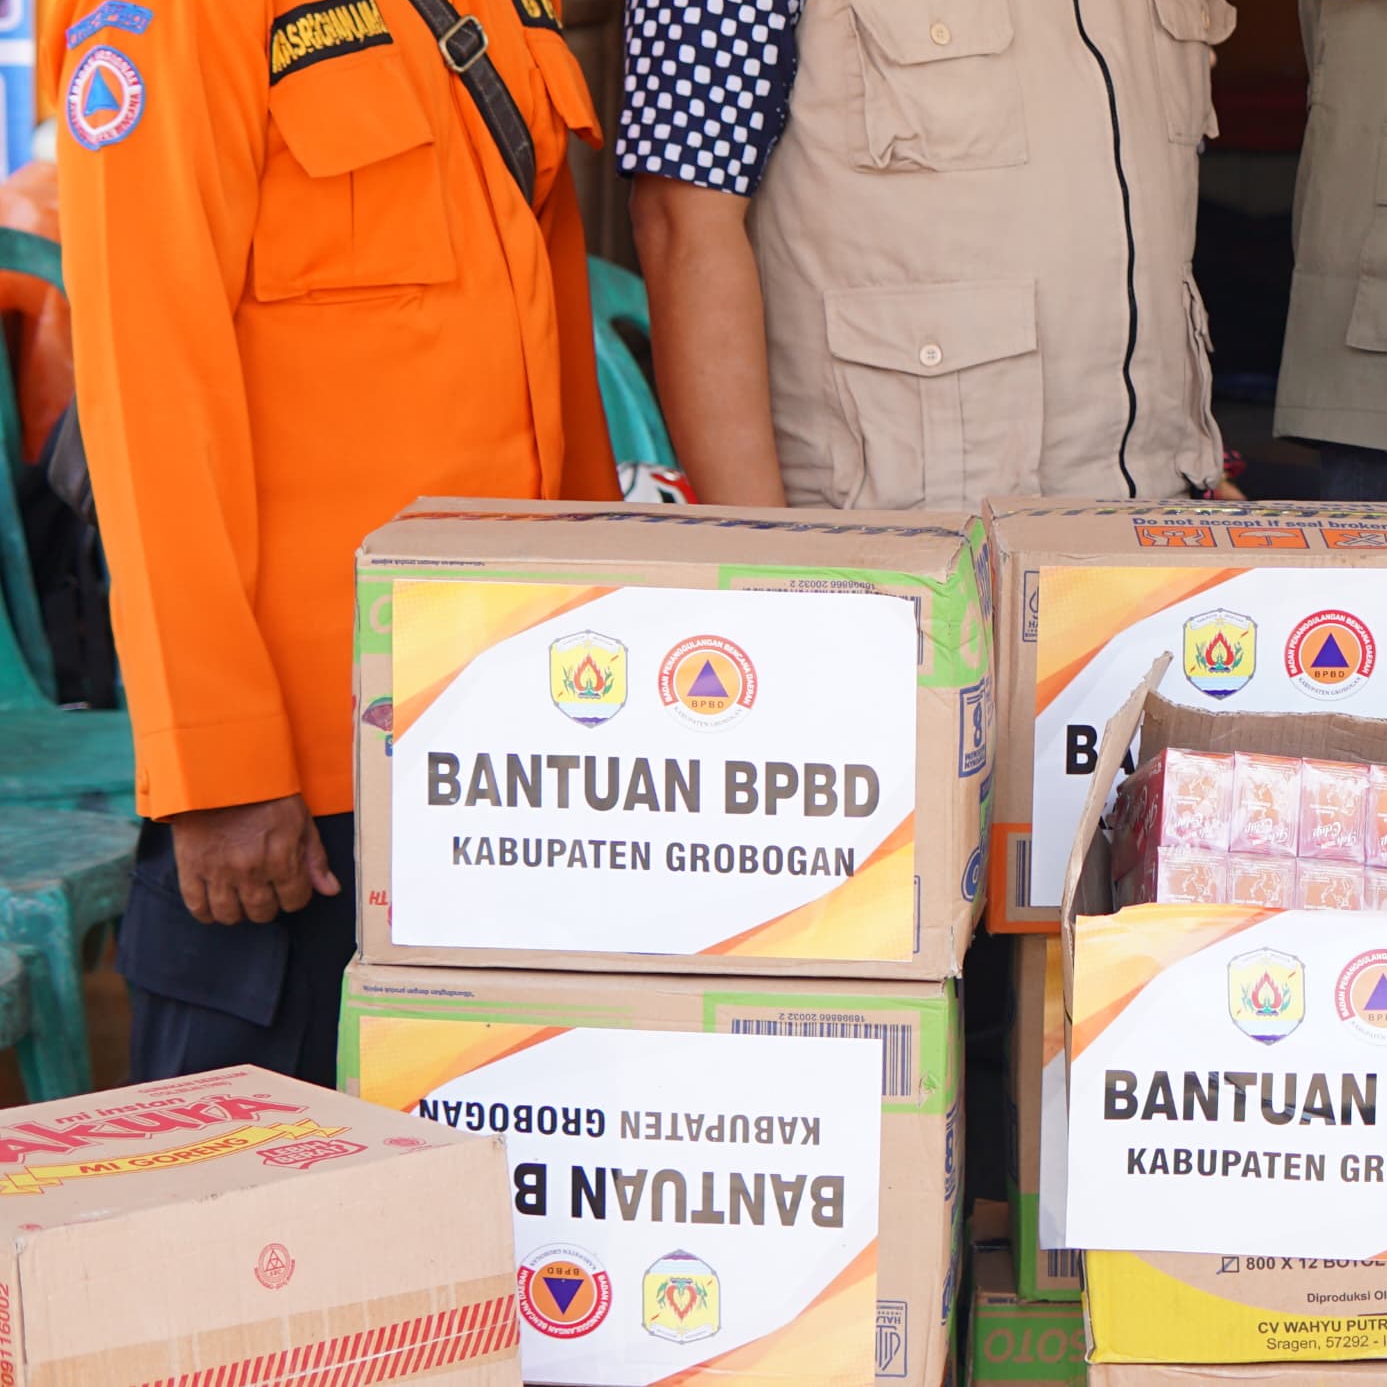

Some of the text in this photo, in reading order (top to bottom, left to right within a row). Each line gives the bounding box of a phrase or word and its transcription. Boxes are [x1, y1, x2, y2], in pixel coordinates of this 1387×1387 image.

[1132, 517, 1158, 526] Do
[1164, 518, 1194, 526] not
[1199, 519, 1261, 529] accept
[1265, 518, 1281, 528] if
[1285, 520, 1323, 529] seal
[1314, 670, 1345, 678] BPBD
[691, 700, 725, 709] BPBD
[427, 751, 881, 818] BANTUAN BPBD
[452, 835, 856, 878] KABUPATEN GROBOGAN
[788, 1013, 817, 1022] 20032
[1103, 1070, 1378, 1127] BANTUAN
[55, 1097, 188, 1125] mi instan
[419, 1098, 821, 1146] GROBOGAN KABUPATEN
[80, 1136, 250, 1176] MI GORENG
[265, 1140, 328, 1158] LEBIH
[1126, 1148, 1326, 1182] KABUPATEN
[571, 1164, 845, 1228] BANTUAN
[547, 1267, 580, 1276] BPBD
[1246, 1257, 1270, 1271] 800
[1281, 1258, 1293, 1270] X
[1299, 1258, 1318, 1270] 12
[1306, 1290, 1372, 1304] Diproduksi
[1257, 1321, 1281, 1335] CV
[1284, 1319, 1343, 1334] WAHYU
[1266, 1337, 1322, 1352] Sragen,
[1325, 1335, 1370, 1349] 57292
